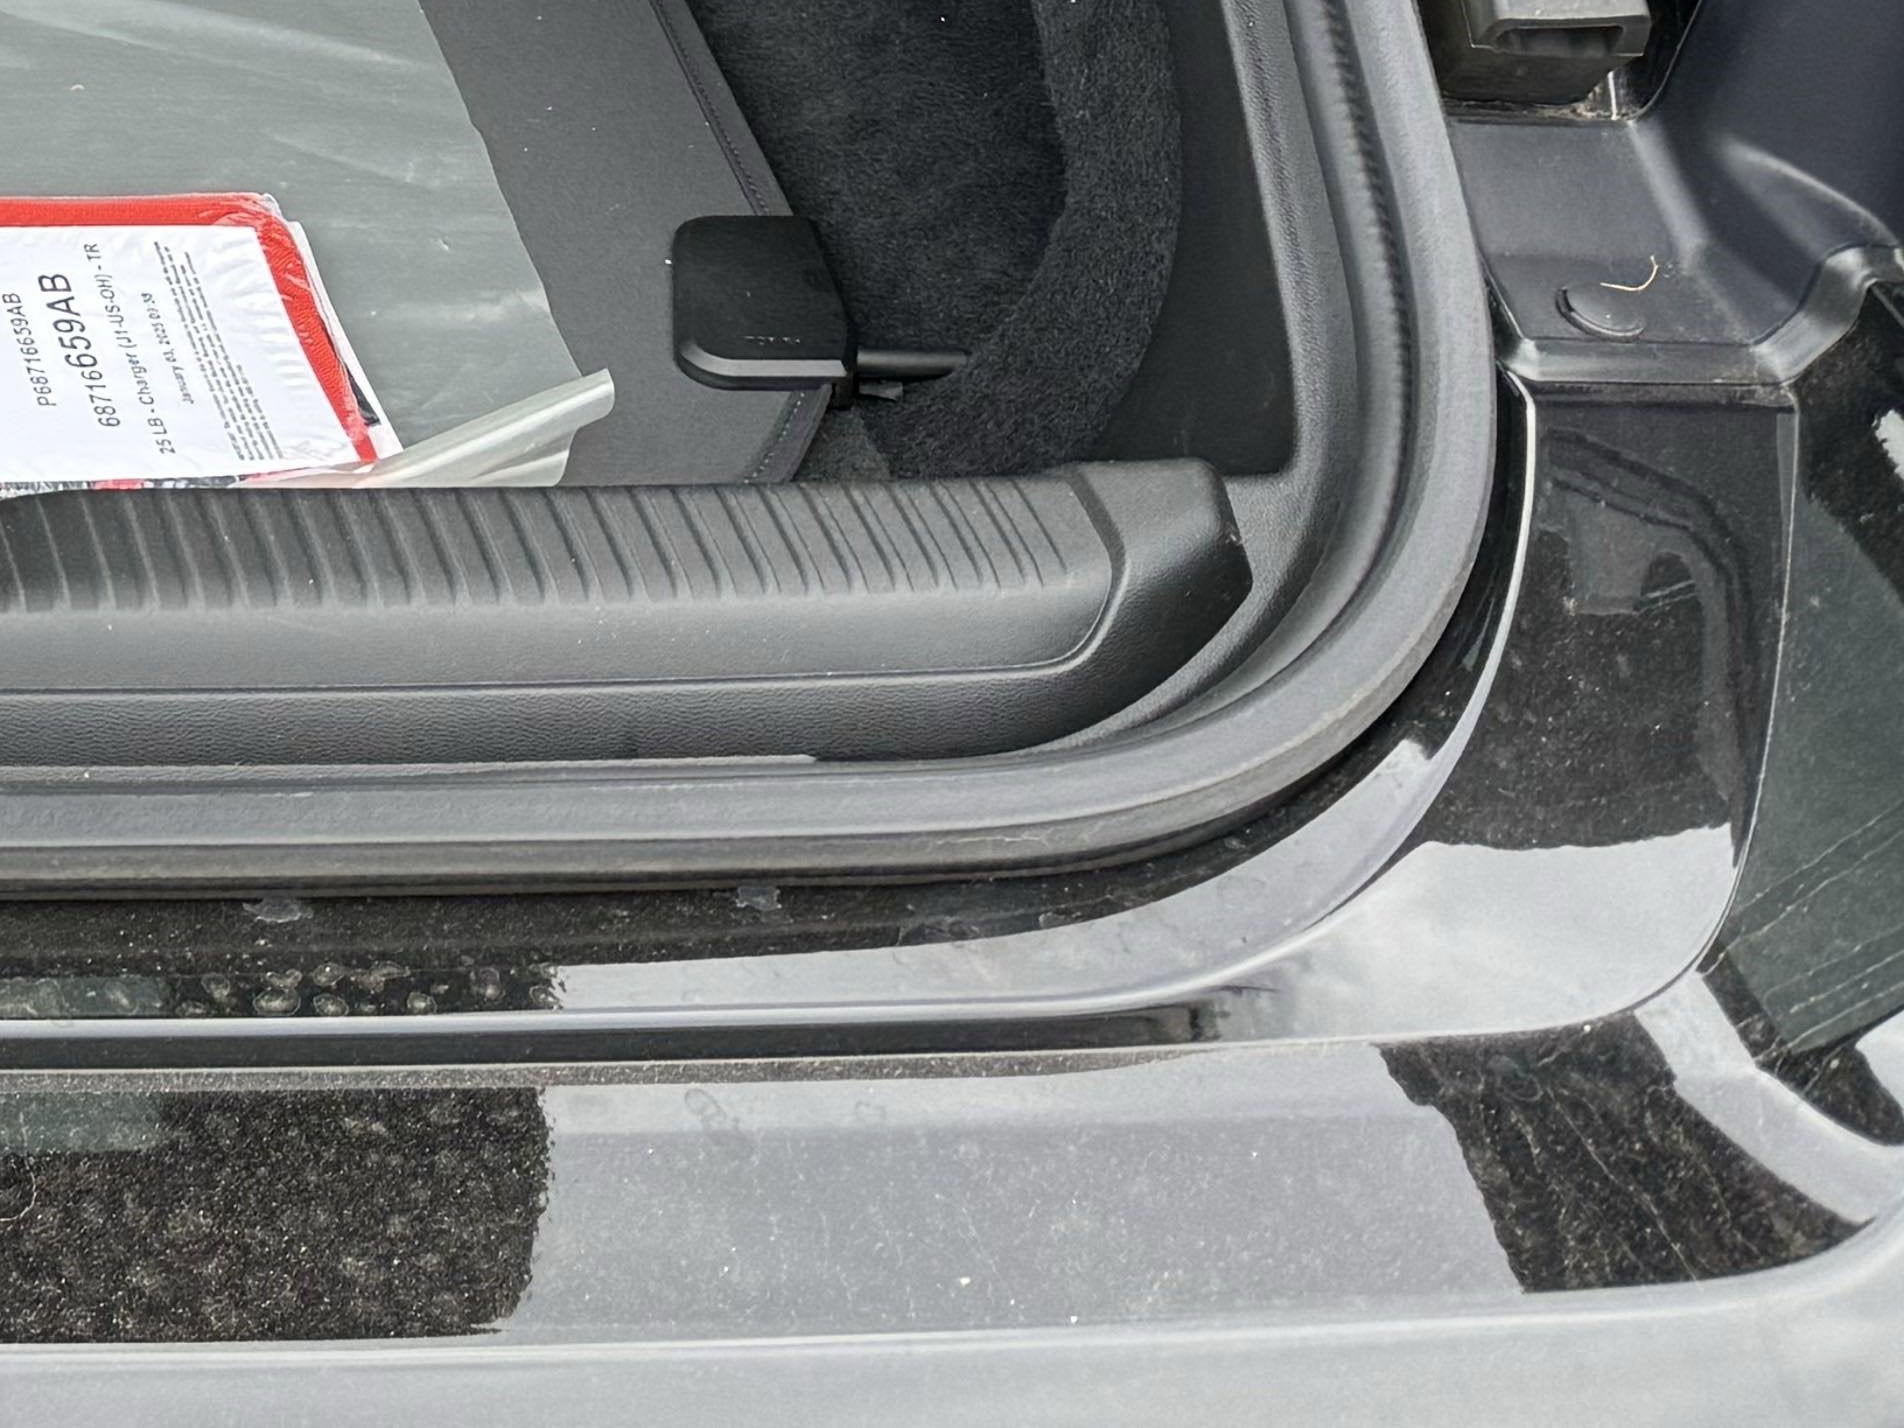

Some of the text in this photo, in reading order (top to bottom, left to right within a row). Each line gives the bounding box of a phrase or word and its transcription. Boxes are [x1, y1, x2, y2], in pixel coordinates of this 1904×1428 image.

[83, 242, 102, 262] TR
[2, 292, 56, 407] P68716659AB
[37, 273, 121, 428] 68716659AB
[125, 352, 155, 405] Charger
[171, 365, 195, 405] January
[147, 417, 168, 435] LB
[155, 438, 176, 456] 25
